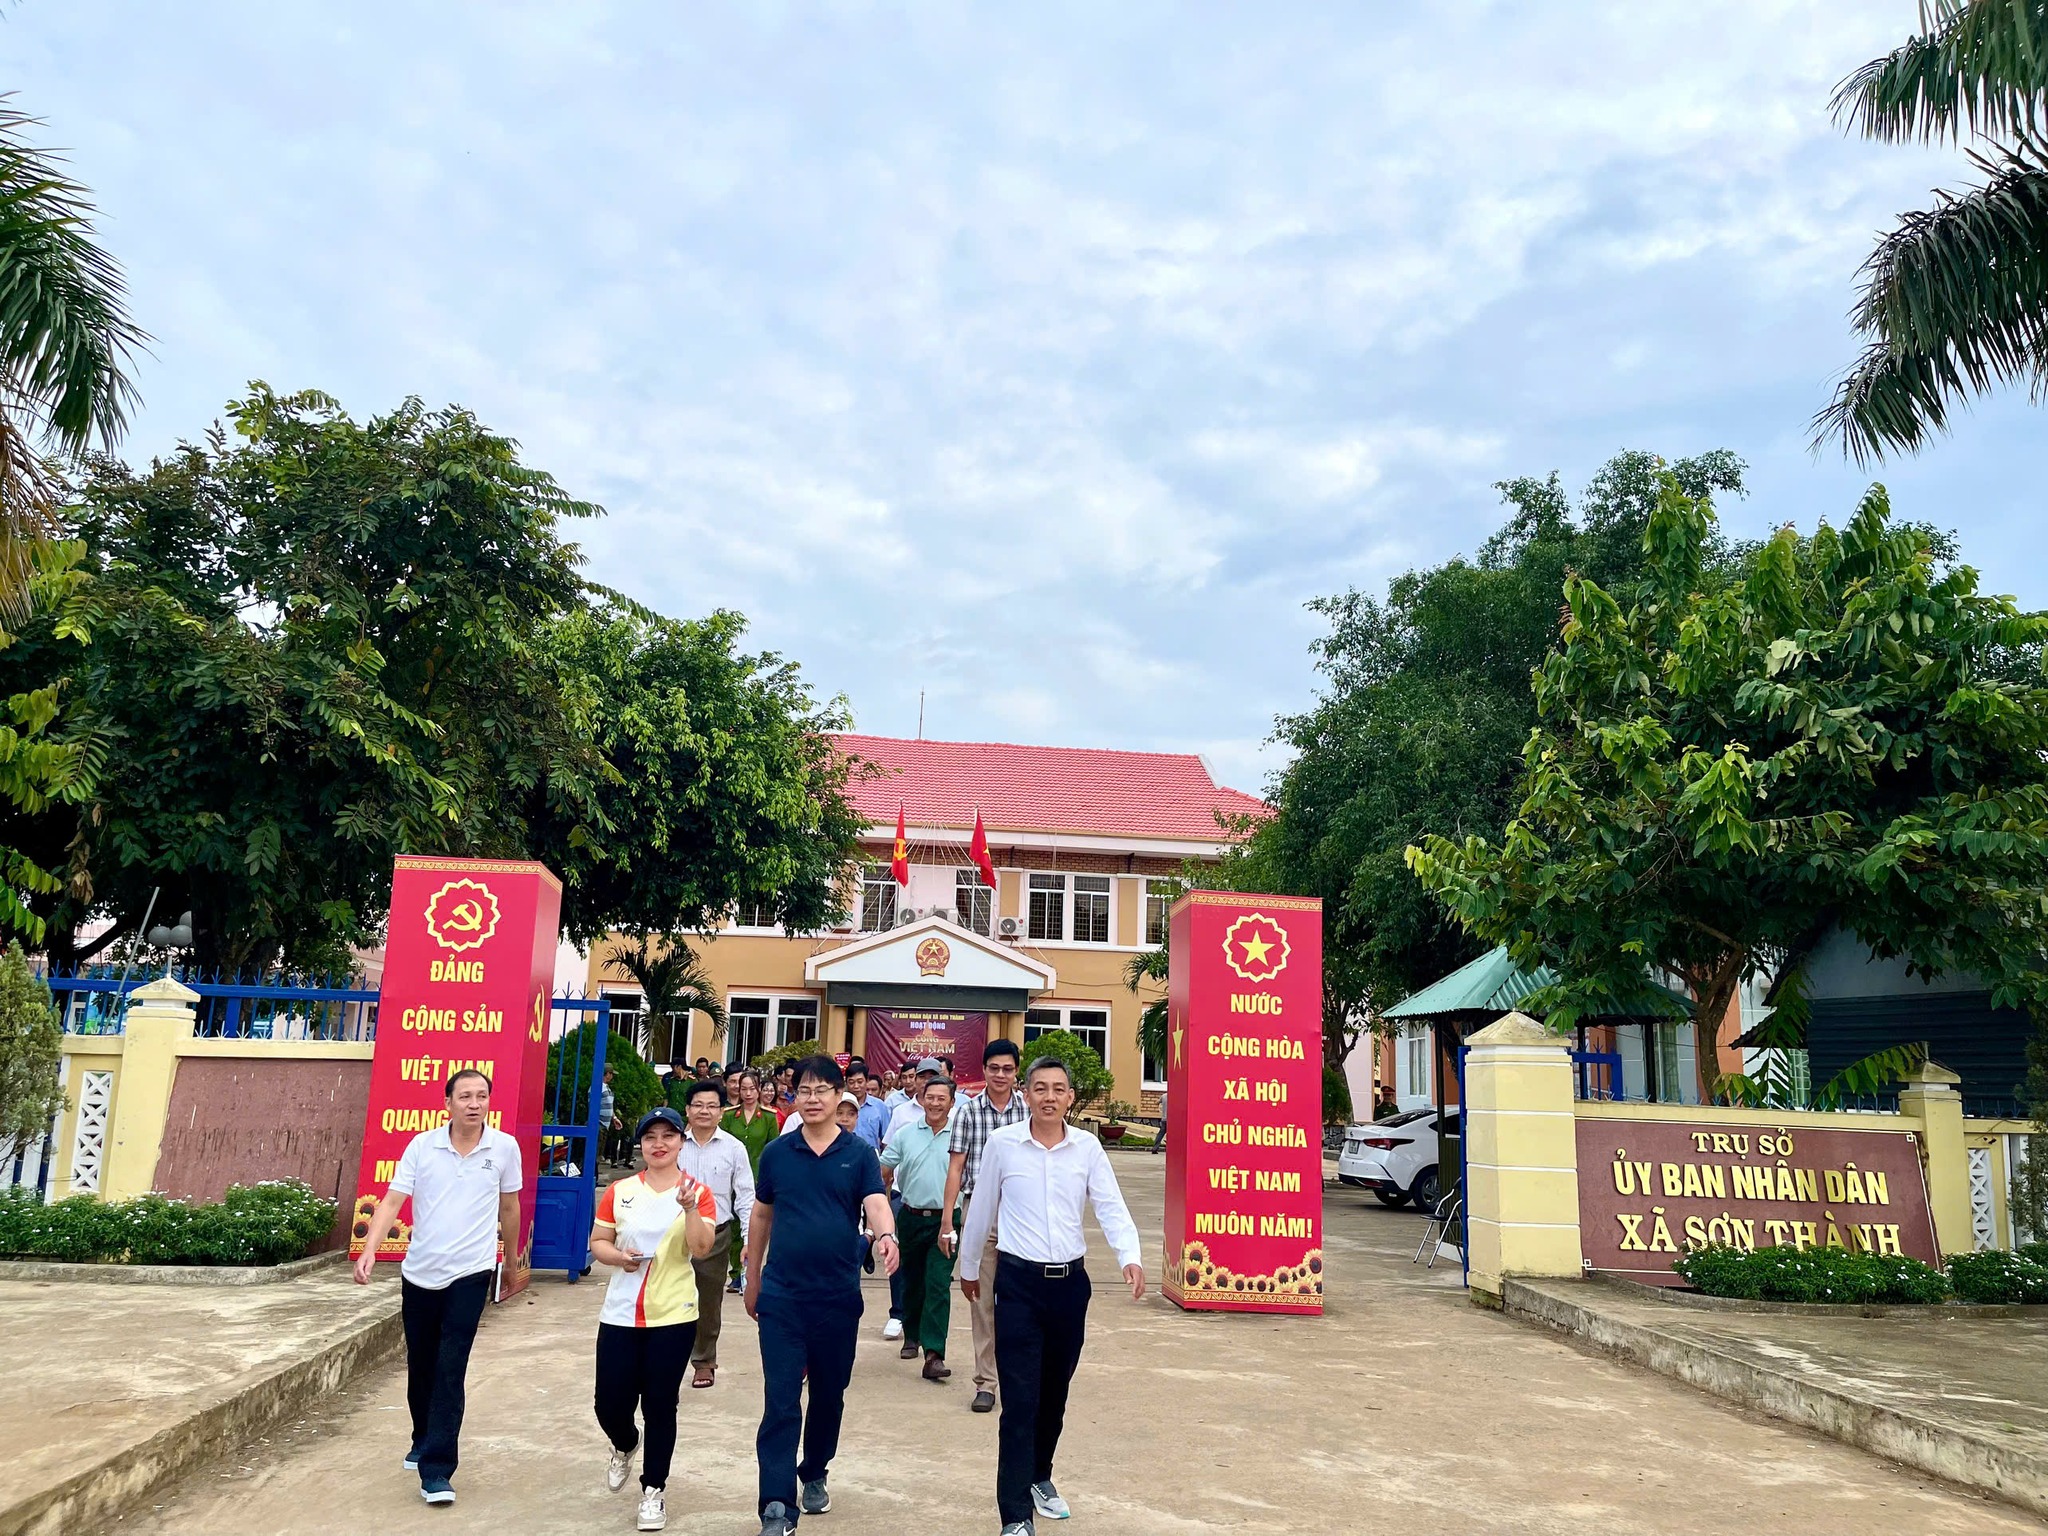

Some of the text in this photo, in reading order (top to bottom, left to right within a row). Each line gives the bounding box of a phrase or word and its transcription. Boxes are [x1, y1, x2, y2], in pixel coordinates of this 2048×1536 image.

[430, 954, 484, 983] ĐẢNG
[1230, 992, 1283, 1015] NƯỚC
[402, 1003, 503, 1036] CỘNG SẢN
[910, 1021, 946, 1030] HOẠT ĐỘNG
[899, 1041, 955, 1054] VIỆT NAM
[1208, 1032, 1304, 1060] CỘNG HÒA
[401, 1054, 443, 1086] VIỆT
[1223, 1078, 1288, 1106] XÃ HỘI
[382, 1109, 449, 1133] QUANG
[1203, 1118, 1307, 1148] CHỦ NGHĨA
[1692, 1127, 1794, 1160] TRỤ SỞ
[1209, 1166, 1300, 1195] VIỆT NAM
[1613, 1148, 1890, 1205] ỦY BAN NHÂN DÂN
[1195, 1211, 1312, 1238] MUÔN NĂM!
[1616, 1206, 1903, 1256] XÃ SƠN THÀNH
